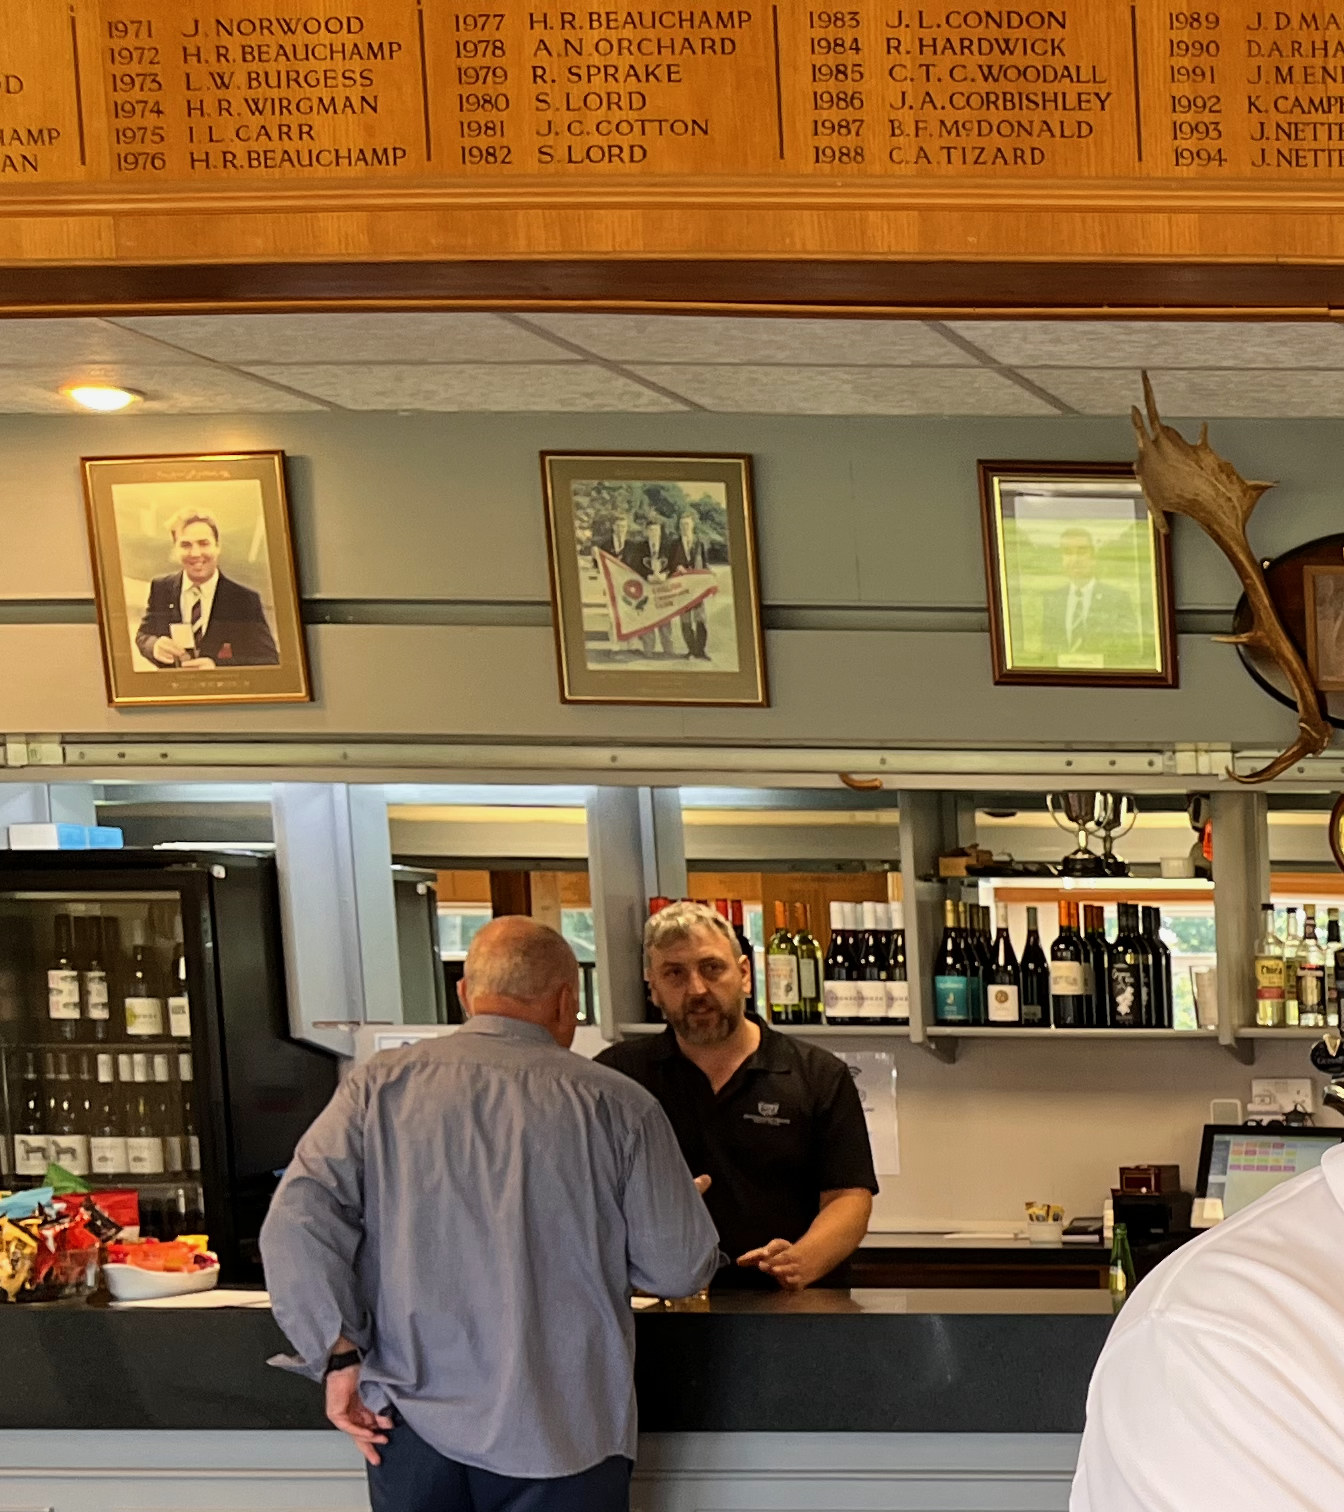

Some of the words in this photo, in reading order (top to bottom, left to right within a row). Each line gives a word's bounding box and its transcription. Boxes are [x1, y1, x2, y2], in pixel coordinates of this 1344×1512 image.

[108, 20, 153, 39] 1971
[454, 14, 504, 32] 1977
[809, 12, 861, 30] 1983
[1169, 12, 1220, 31] 1989
[455, 40, 505, 59] 1978
[810, 37, 861, 55] 1984
[1169, 39, 1220, 58] 1990
[109, 47, 160, 66] 1972
[457, 67, 508, 85] 1979
[811, 64, 863, 82] 1985
[1170, 66, 1215, 85] 1991
[112, 74, 162, 92] 1973
[114, 100, 164, 119] 1974
[459, 94, 510, 112] 1980
[812, 92, 864, 110] 1986
[1171, 95, 1222, 114] 1992
[116, 126, 165, 145] 1975
[460, 120, 504, 138] 1981
[812, 119, 864, 137] 1987
[1172, 121, 1222, 140] 1993
[117, 152, 166, 171] 1976
[461, 147, 511, 165] 1982
[814, 145, 865, 164] 1988
[1174, 147, 1227, 167] 1994
